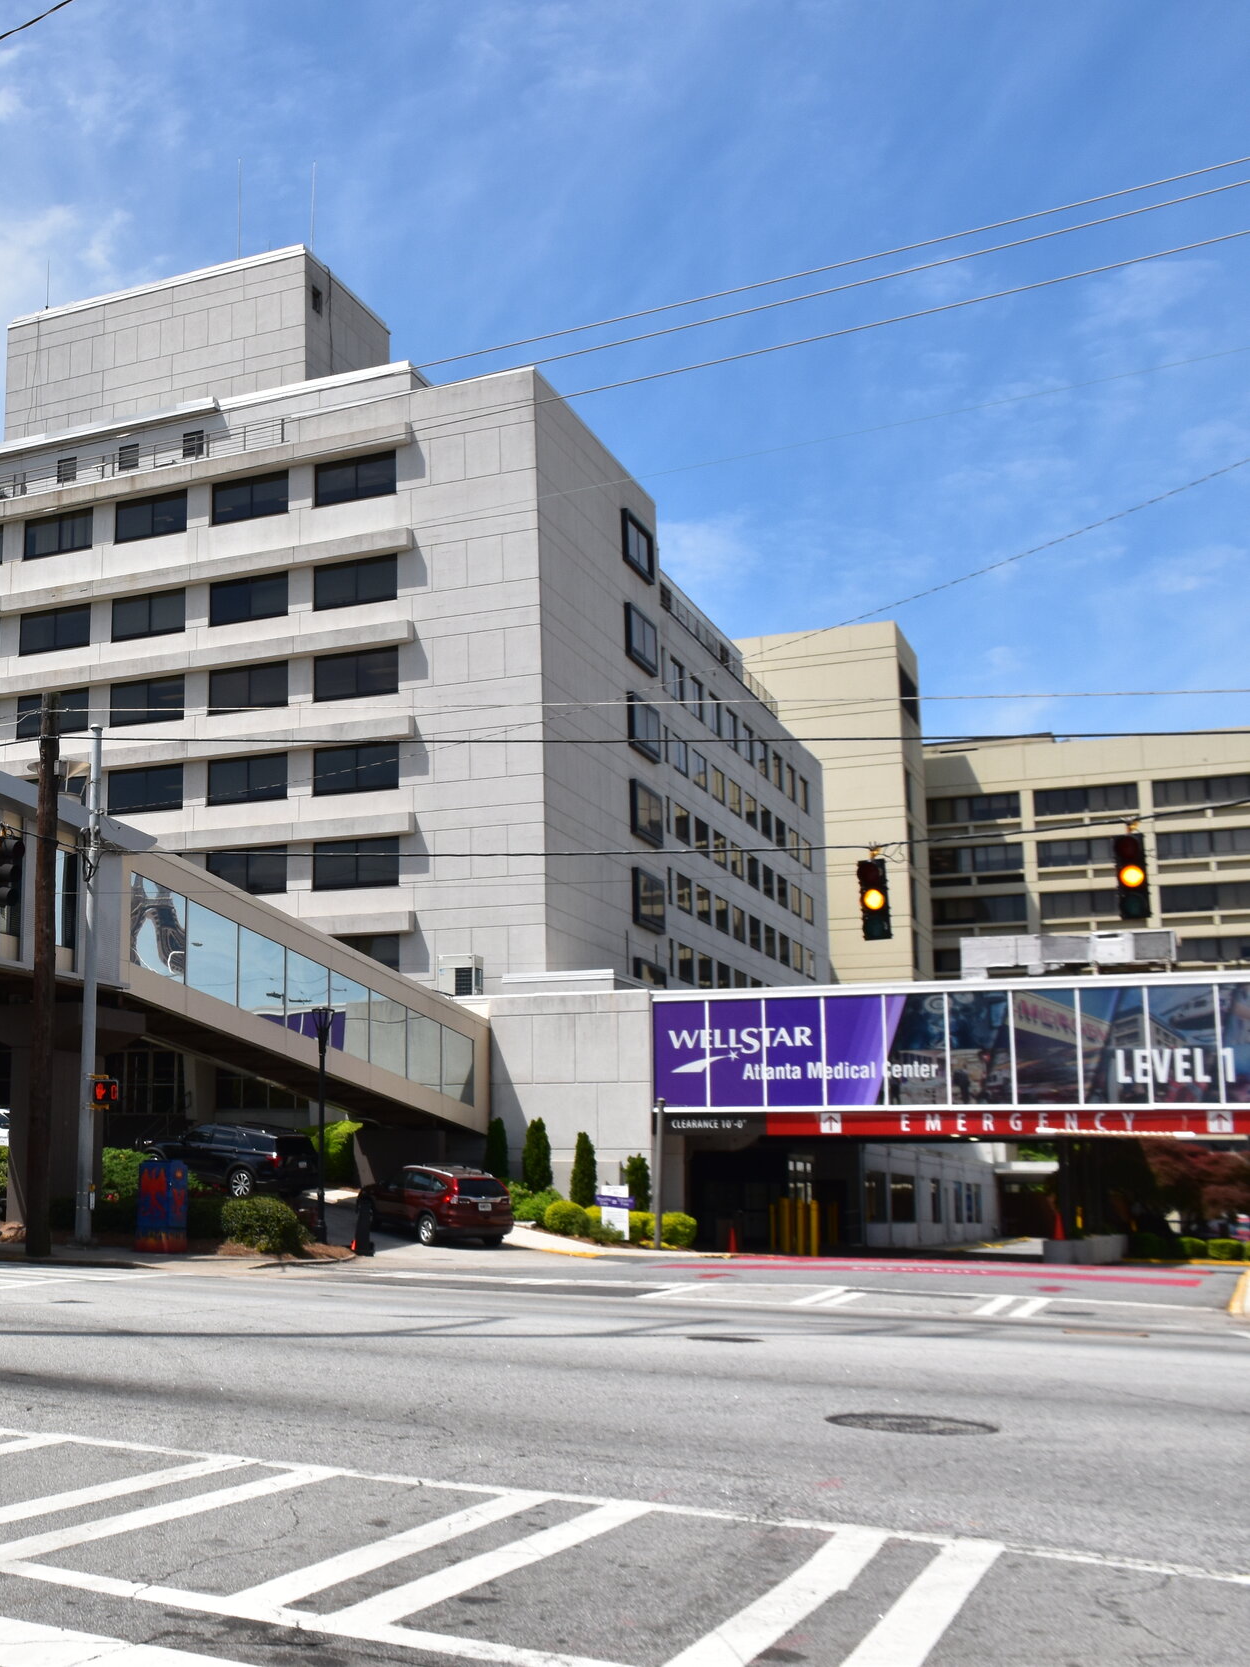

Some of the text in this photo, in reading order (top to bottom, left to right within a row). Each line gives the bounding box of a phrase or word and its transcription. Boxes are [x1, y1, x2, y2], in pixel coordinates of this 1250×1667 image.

[668, 1026, 814, 1054] WELLSTAR
[743, 1060, 938, 1080] Atlanta Medical Center
[1115, 1046, 1237, 1083] LEVEL 1
[671, 1119, 719, 1129] CLEARANCE
[901, 1112, 1135, 1132] EMERGENCY
